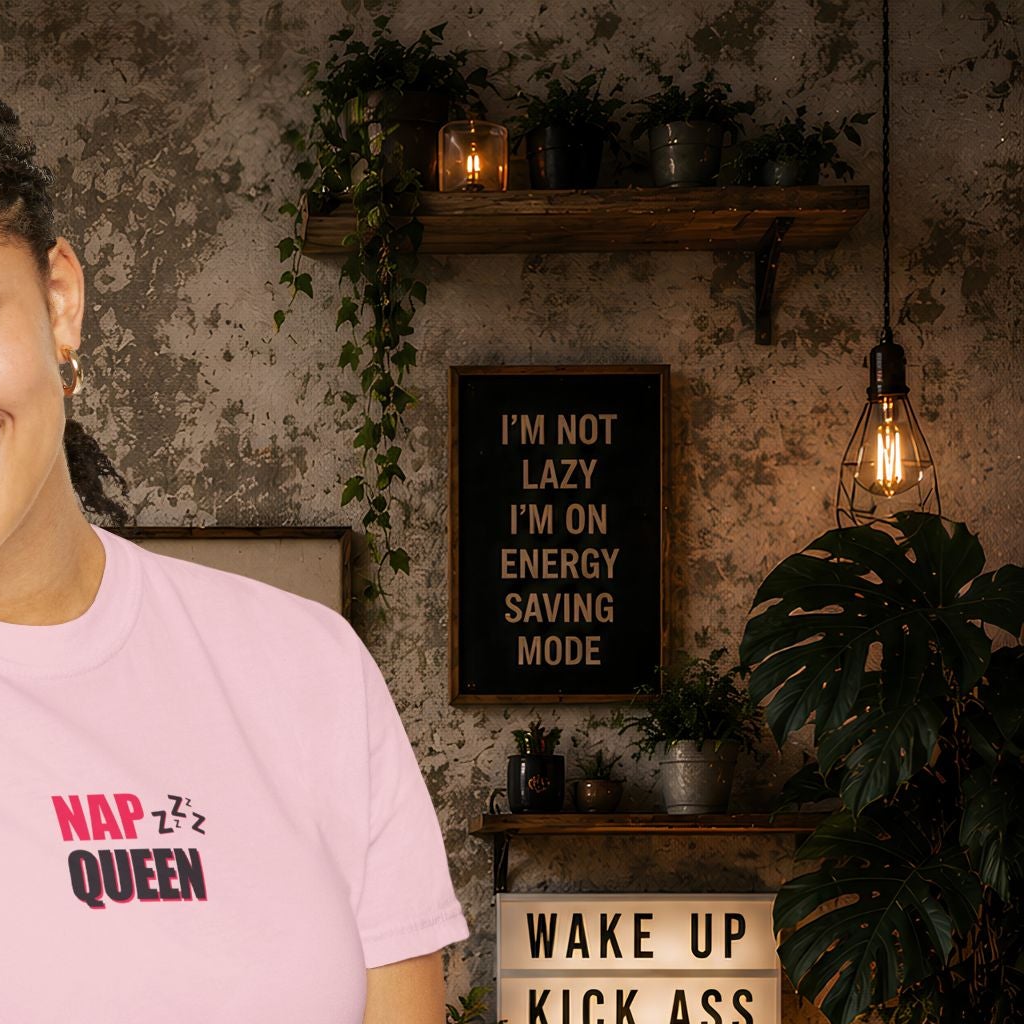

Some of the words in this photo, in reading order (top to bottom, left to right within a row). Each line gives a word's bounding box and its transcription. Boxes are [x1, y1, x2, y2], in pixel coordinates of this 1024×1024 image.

[502, 414, 545, 445] I'M
[557, 414, 618, 445] NOT
[522, 459, 598, 490] LAZY
[510, 504, 554, 535] I'M
[565, 503, 607, 535] ON
[501, 548, 620, 579] ENERGY
[504, 592, 614, 623] SAVING
[518, 635, 601, 666] MODE
[51, 793, 145, 842] NAP
[68, 848, 208, 909] QUEEN
[527, 912, 654, 959] WAKE
[690, 912, 746, 959] UP
